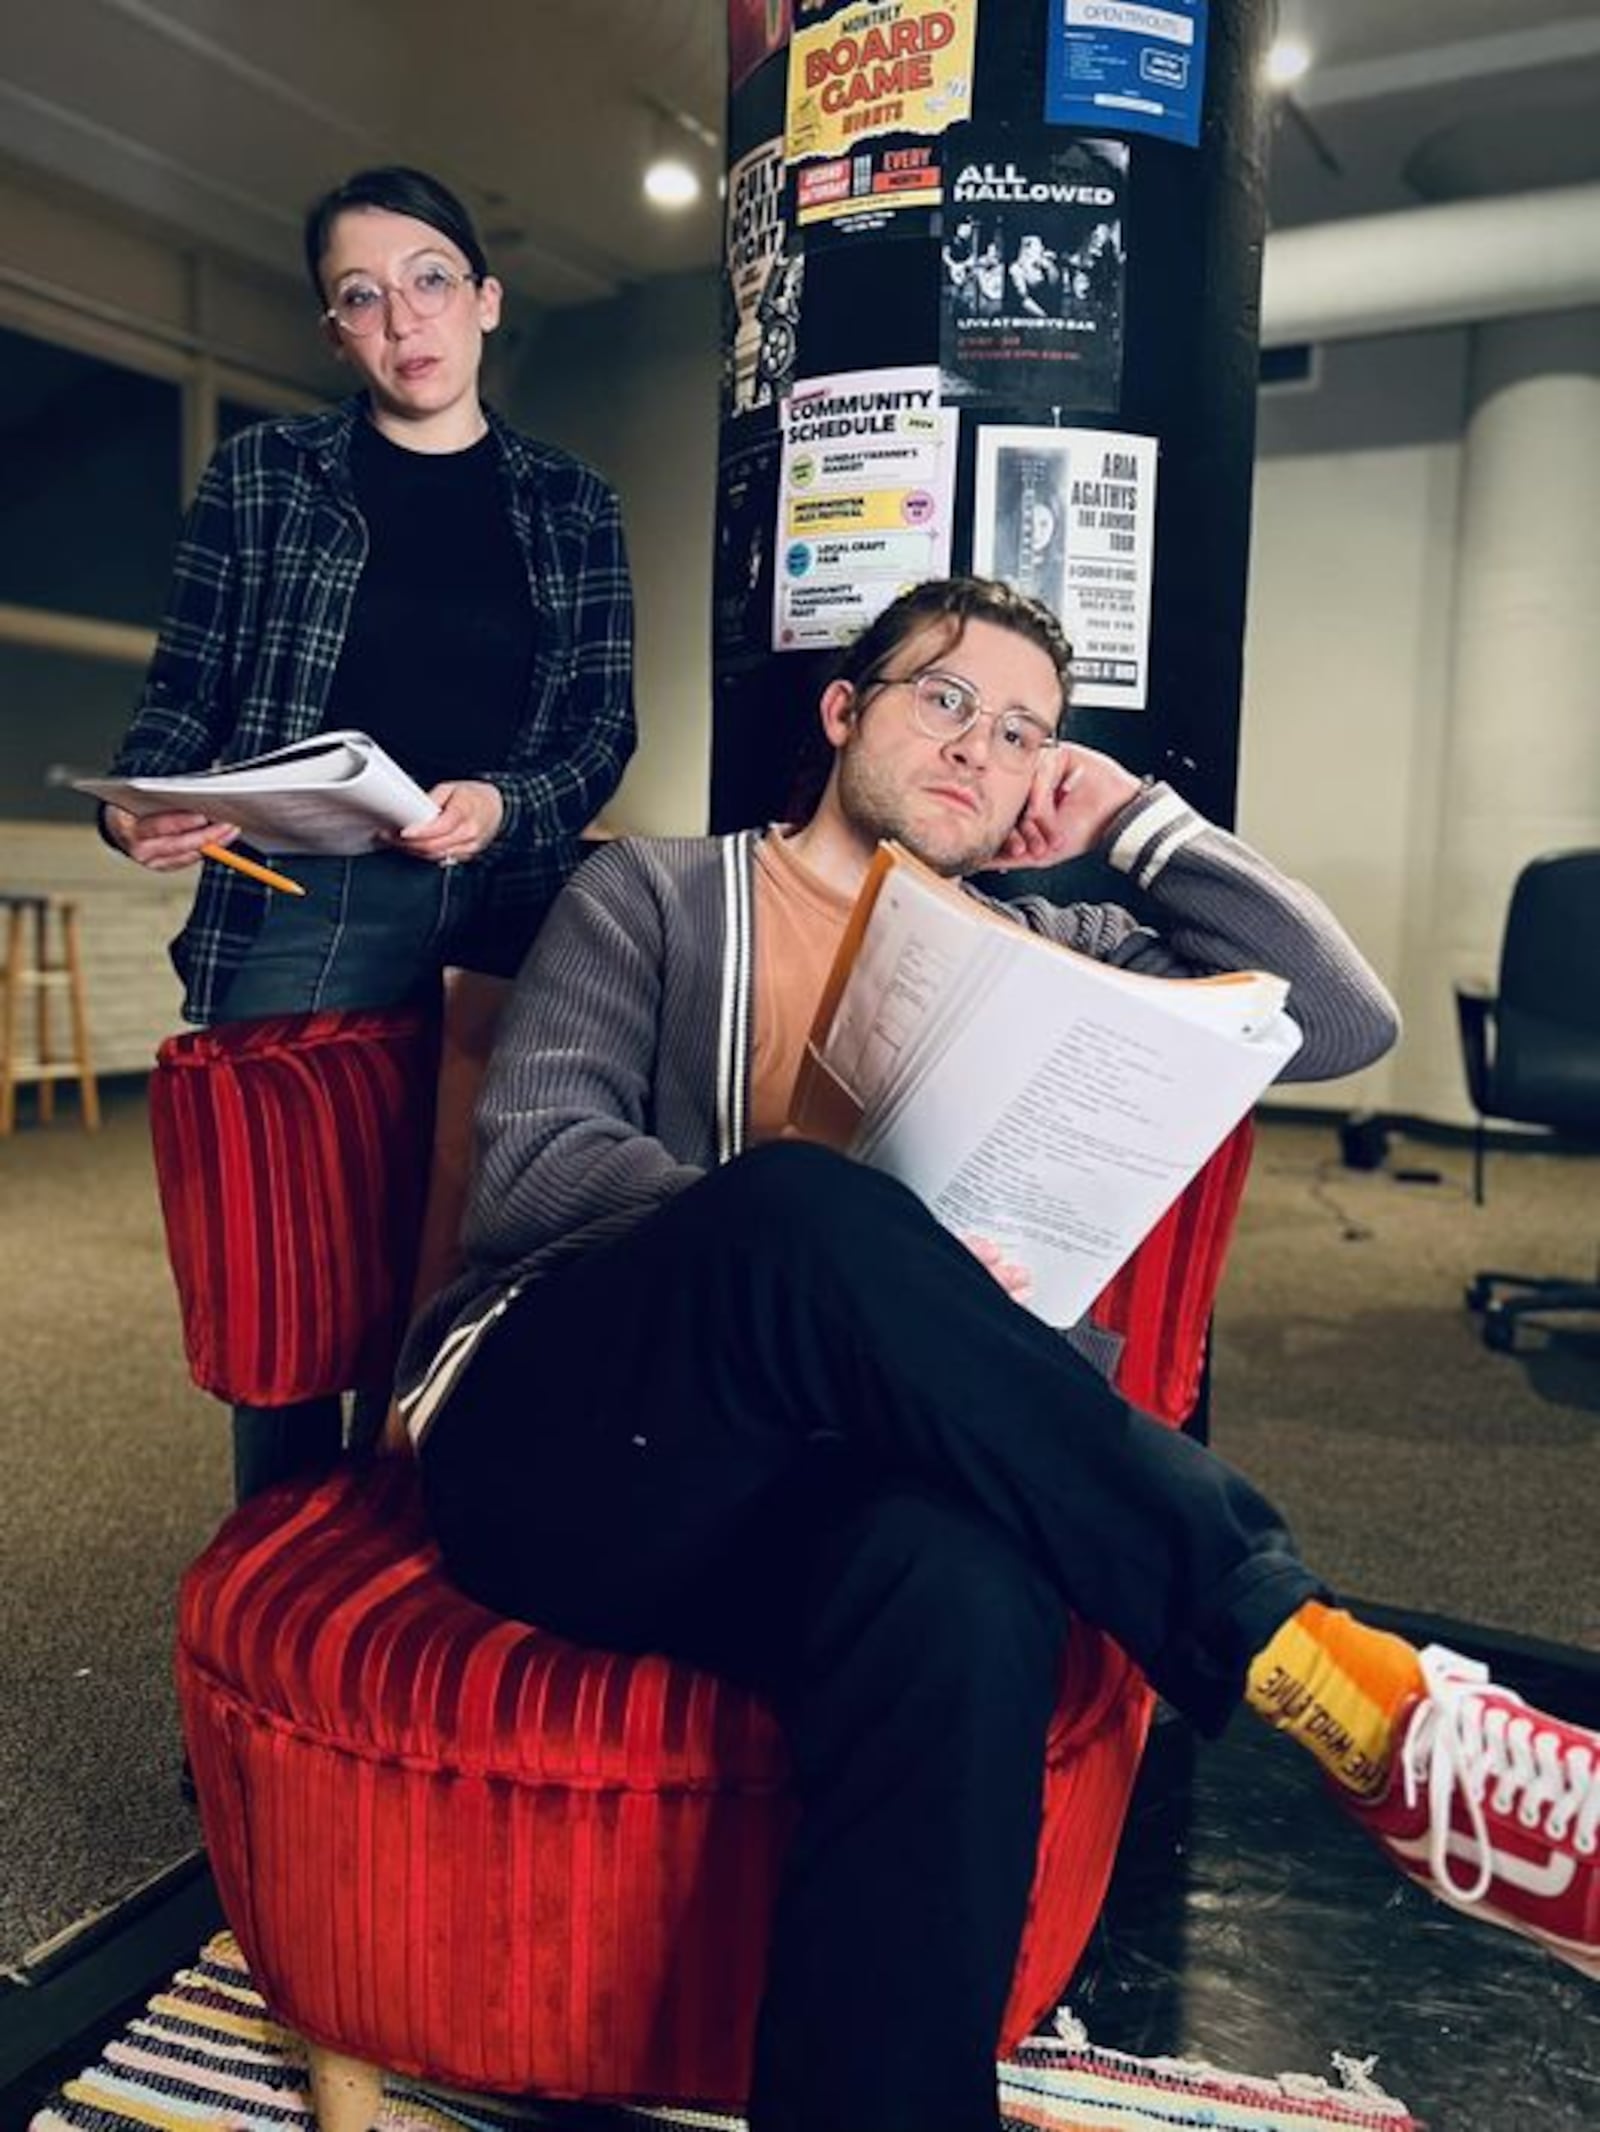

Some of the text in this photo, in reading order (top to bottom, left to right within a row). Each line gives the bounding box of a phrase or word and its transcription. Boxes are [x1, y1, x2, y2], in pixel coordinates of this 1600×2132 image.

[805, 12, 955, 90] BOARD
[821, 54, 933, 115] GAME
[883, 147, 932, 171] EVERY
[956, 163, 1028, 185] ALL
[954, 184, 1116, 206] HALLOWED
[991, 318, 1009, 328] AT
[789, 389, 934, 422] COMMUNITY
[788, 414, 896, 444] SCHEDULE
[1102, 453, 1138, 482] ARIA
[1070, 480, 1137, 511] AGATHYS
[1077, 510, 1097, 527] THE
[817, 541, 886, 554] LOCAL CRAFT
